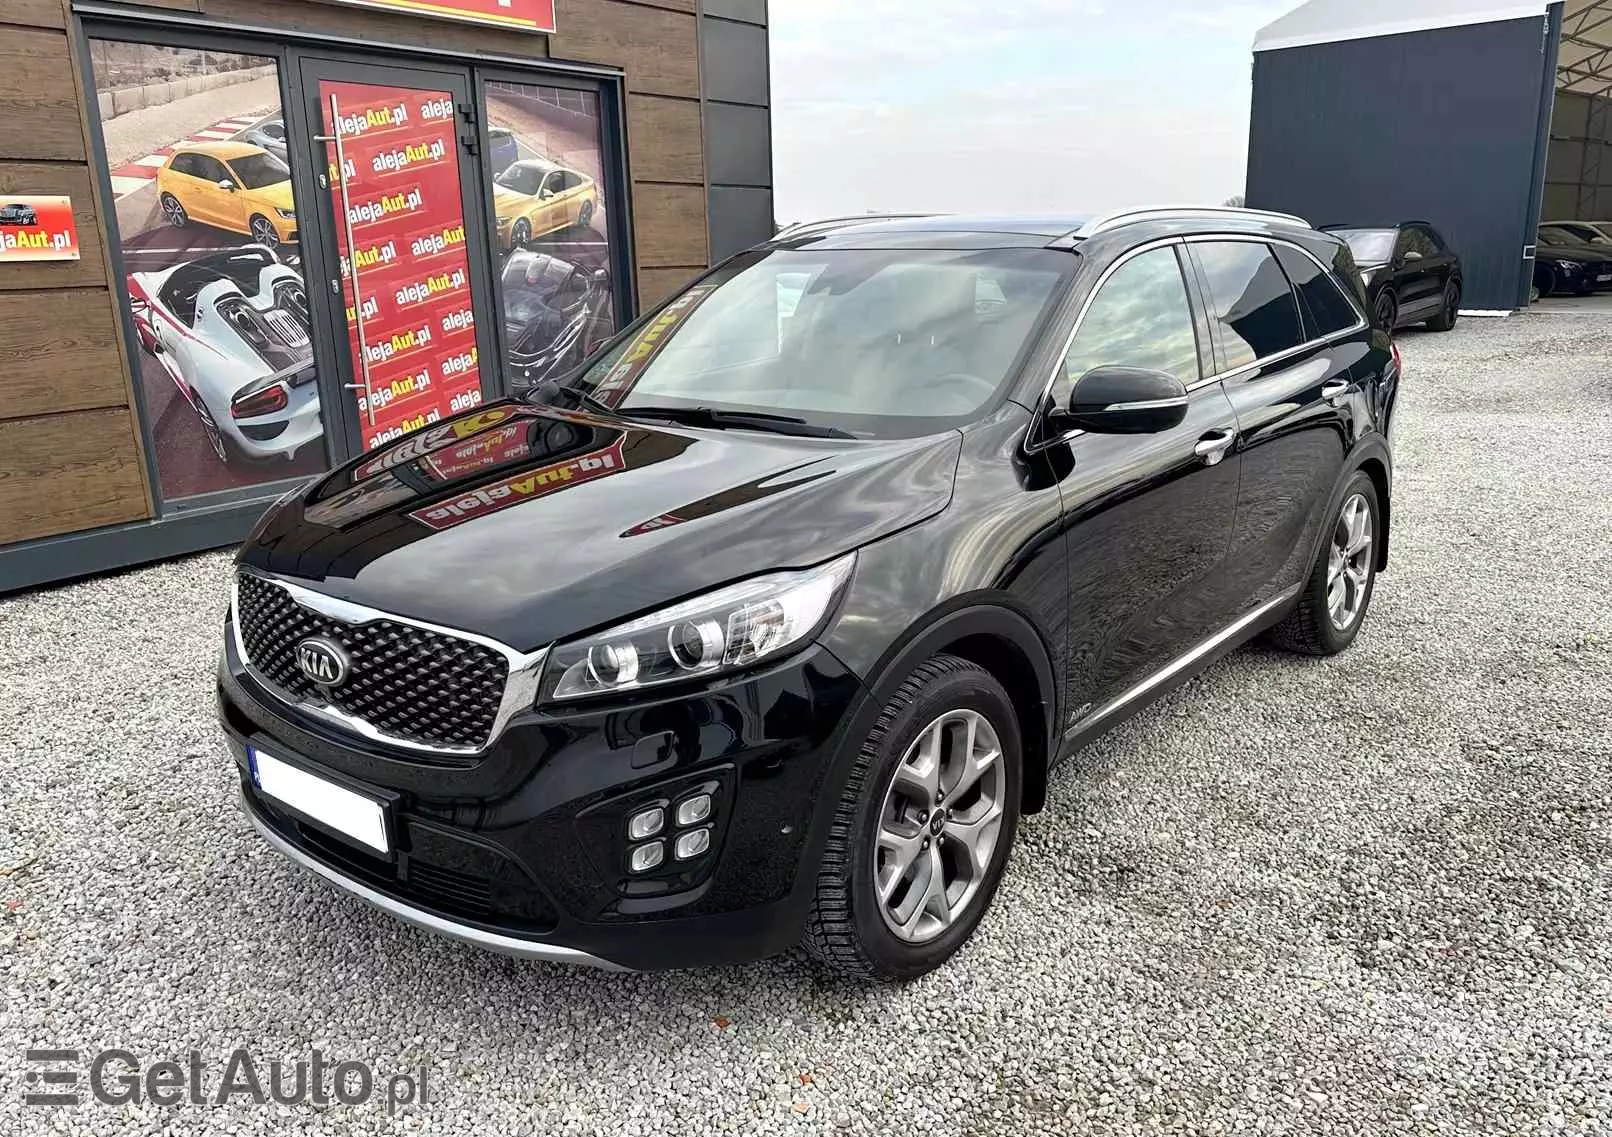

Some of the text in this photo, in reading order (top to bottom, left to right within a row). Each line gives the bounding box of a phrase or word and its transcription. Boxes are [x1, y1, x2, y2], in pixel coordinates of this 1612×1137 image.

[331, 103, 408, 136] lejaAut.pl
[372, 138, 445, 172] alejaAut.pl
[349, 188, 422, 224] alejaAut.pl
[396, 268, 466, 305] alejaAut.pl
[442, 309, 474, 331] aleja
[358, 325, 432, 361] lejaAut.pl
[358, 369, 431, 411] aejaAut.pl
[300, 647, 334, 680] KIA
